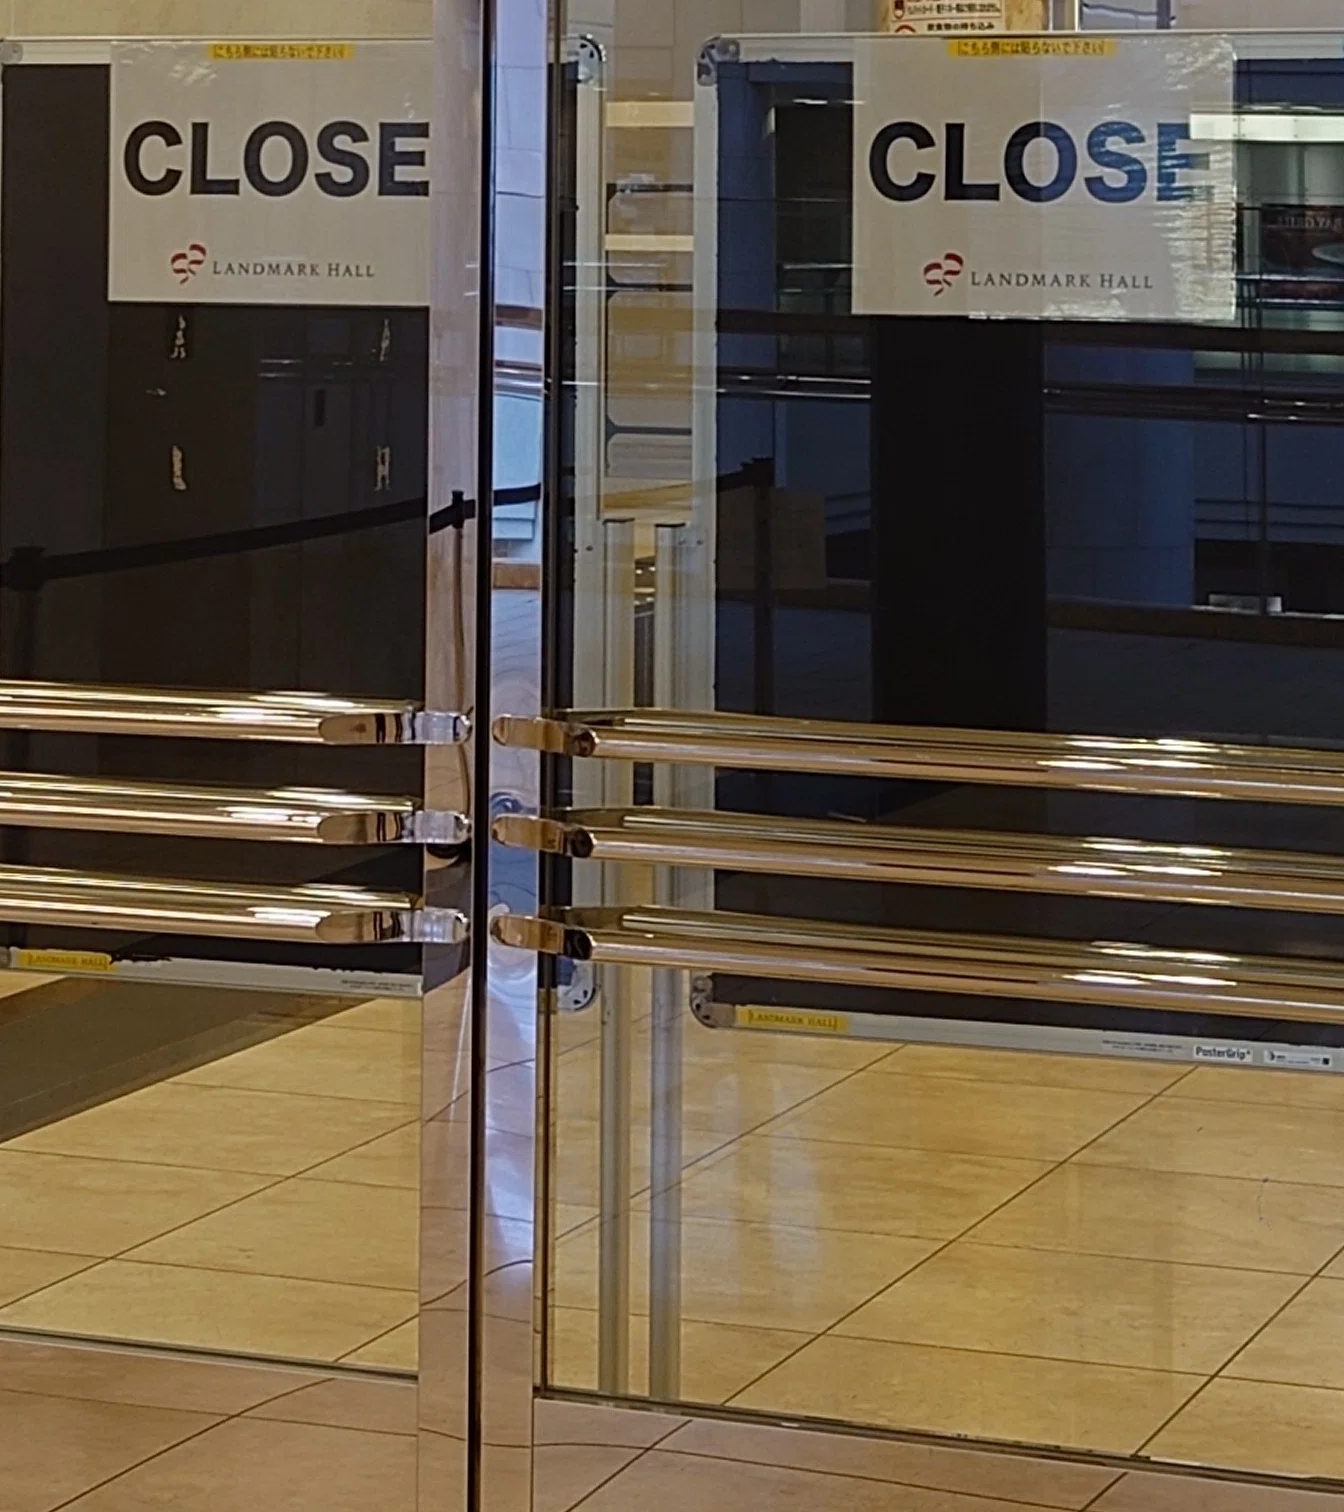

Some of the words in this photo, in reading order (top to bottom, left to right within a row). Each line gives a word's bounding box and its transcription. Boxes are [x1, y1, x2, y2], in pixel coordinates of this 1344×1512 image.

[123, 120, 431, 198] CLOSE
[868, 121, 1212, 203] CLOSE
[212, 259, 320, 277] LANDMARK
[327, 261, 376, 278] HALL
[970, 271, 1091, 289] LANDMARK
[1099, 273, 1154, 290] HALL
